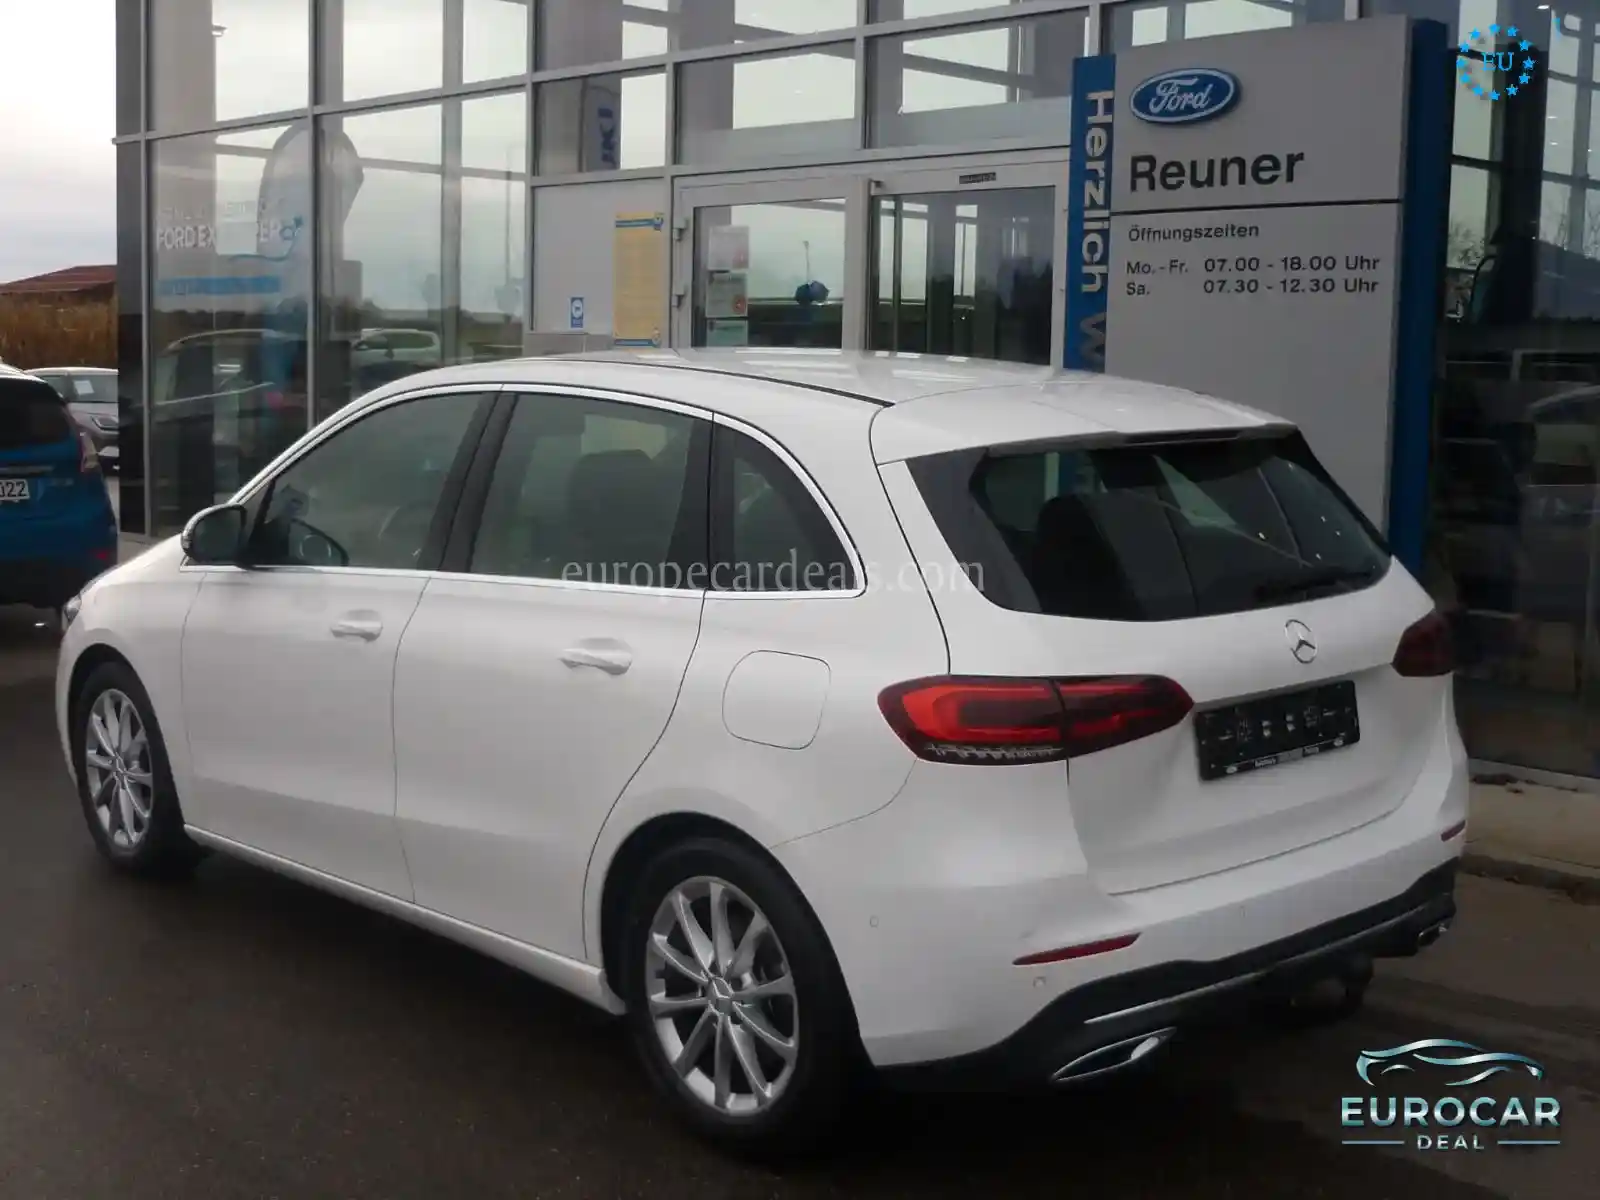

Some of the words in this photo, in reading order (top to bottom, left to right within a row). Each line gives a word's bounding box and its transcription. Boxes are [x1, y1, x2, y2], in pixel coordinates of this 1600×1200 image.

[1149, 77, 1214, 113] Ford
[1130, 151, 1304, 193] Reuner
[1081, 90, 1115, 293] Herzlich
[1128, 223, 1260, 243] Öffnungszeiten
[1204, 257, 1260, 272] 07.00
[1282, 255, 1336, 271] 18.00
[1345, 255, 1380, 271] Uhr
[1126, 281, 1150, 296] Sa.
[1203, 277, 1259, 294] 07.30
[1280, 277, 1335, 293] 12.30
[1344, 277, 1379, 293] Uhr
